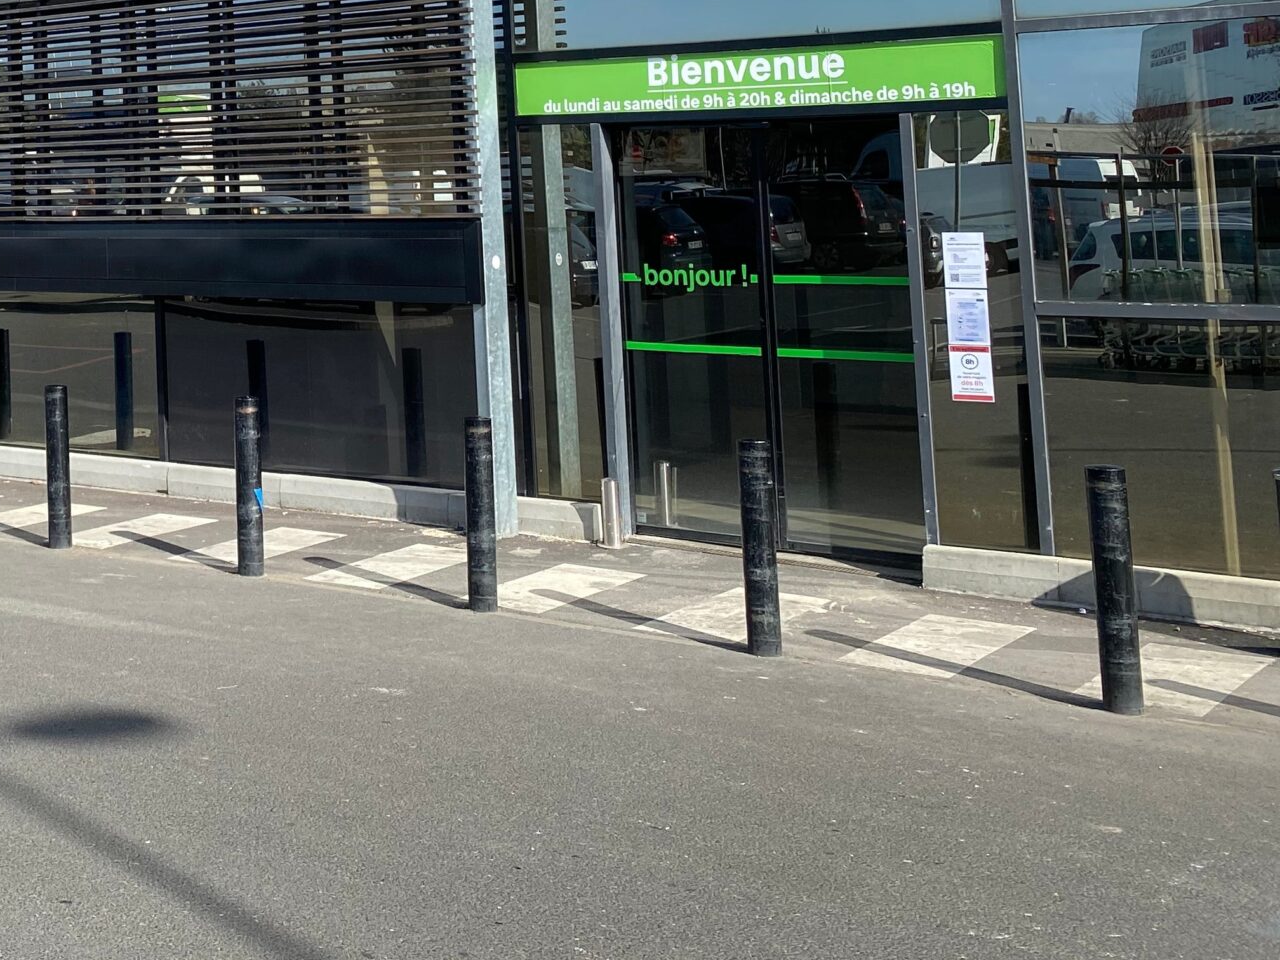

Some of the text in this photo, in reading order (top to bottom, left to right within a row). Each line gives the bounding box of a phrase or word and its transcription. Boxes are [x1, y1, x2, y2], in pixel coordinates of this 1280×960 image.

[647, 52, 846, 87] Bienvenue
[543, 81, 977, 113] du lundi au samedi de 9h à 20h & dimanche de 9h à 19h
[643, 263, 736, 292] bonjour
